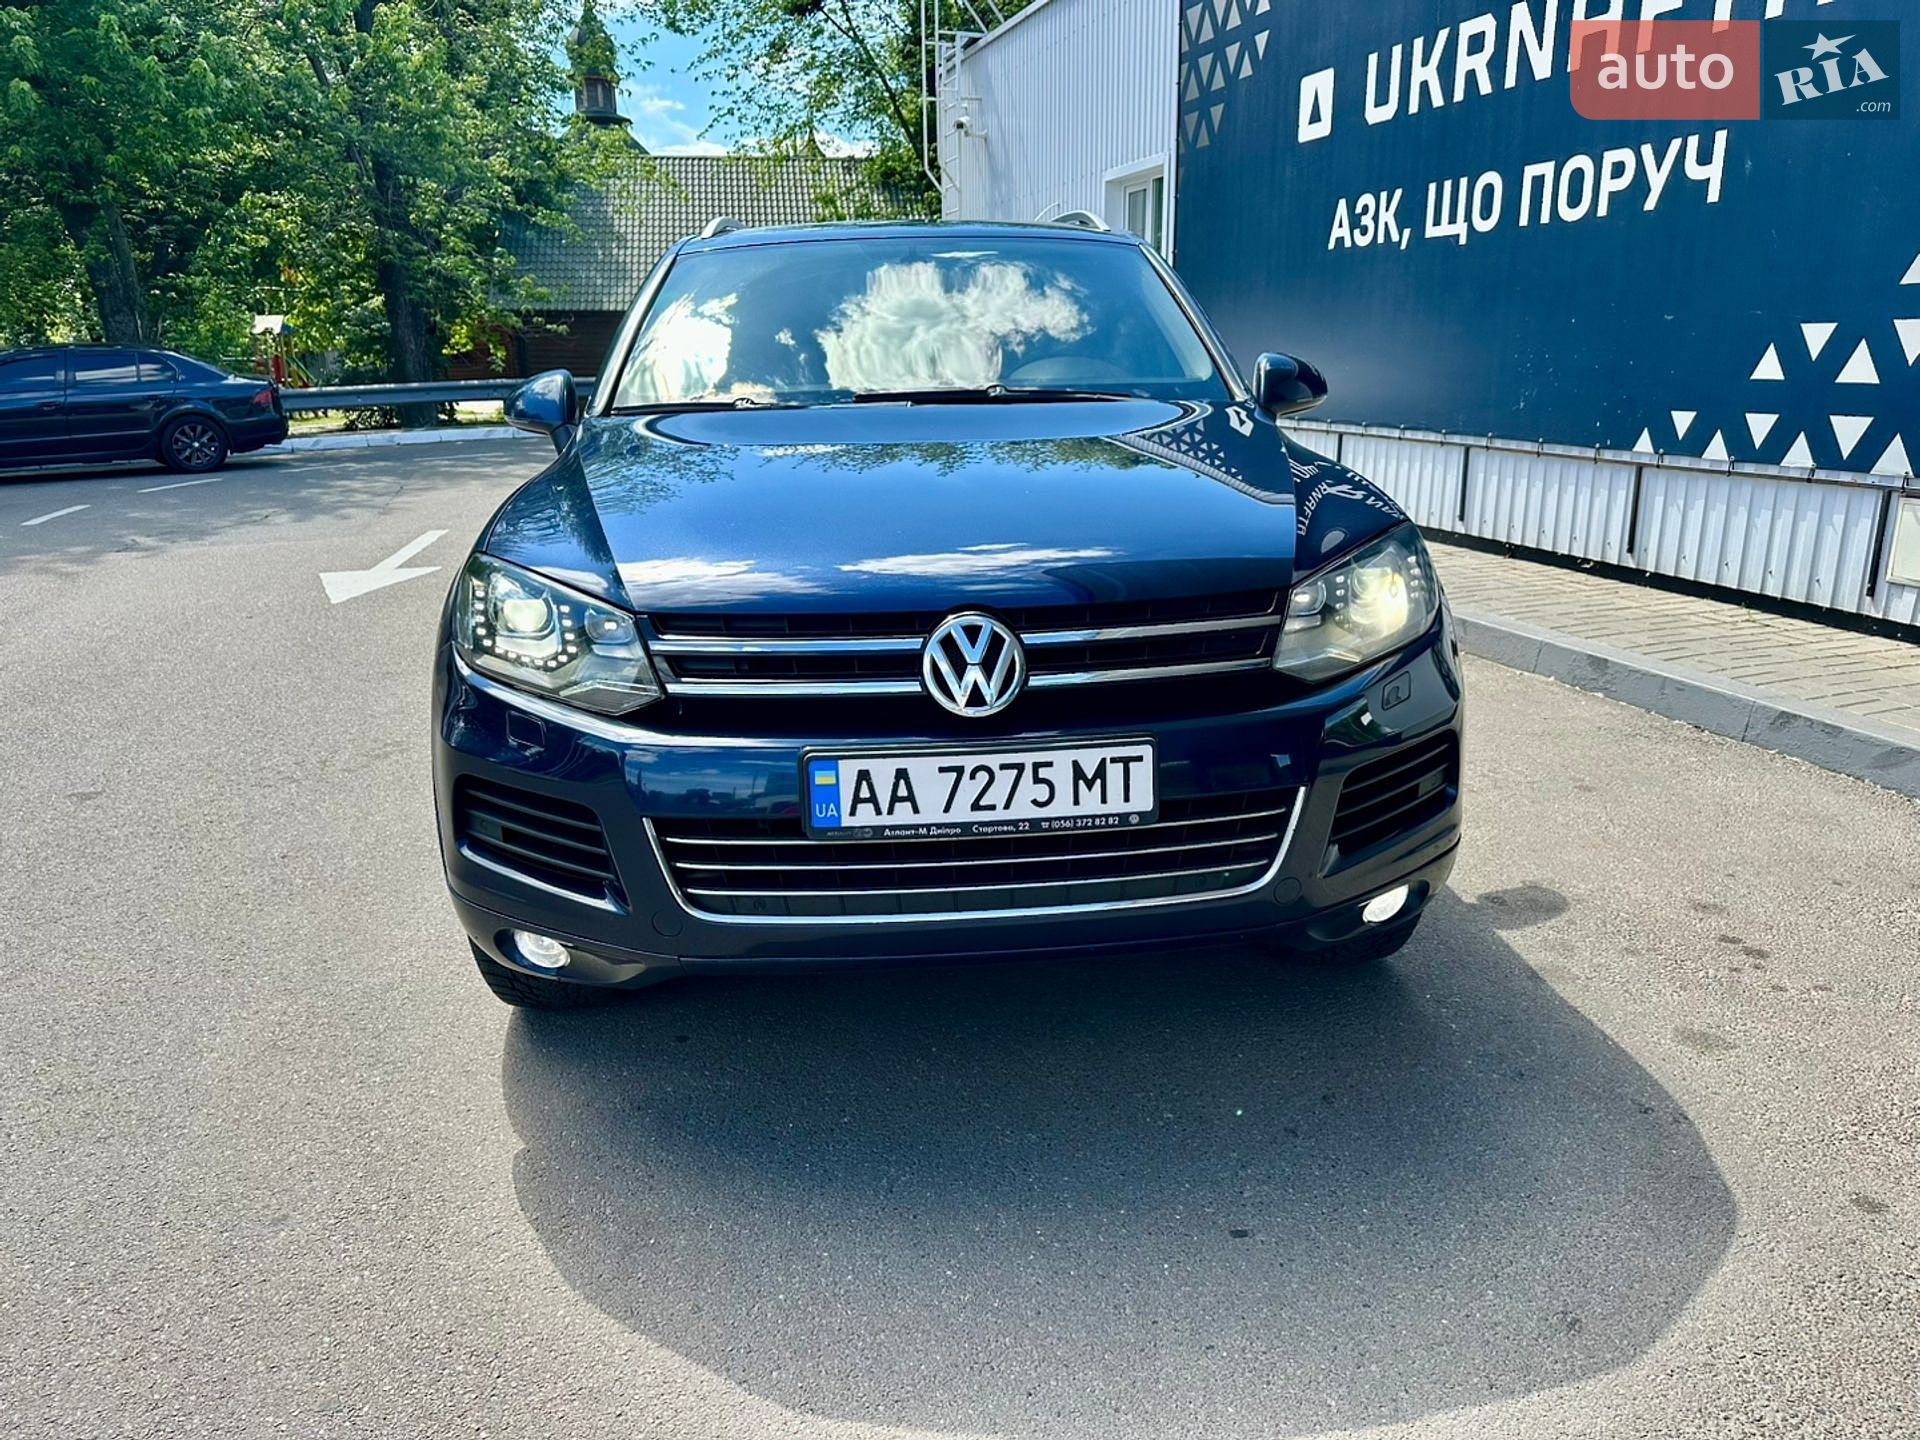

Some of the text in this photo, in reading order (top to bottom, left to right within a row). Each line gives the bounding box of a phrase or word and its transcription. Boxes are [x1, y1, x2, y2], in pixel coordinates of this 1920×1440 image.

[1328, 129, 1728, 250] АЗК, ЩО ПОРУЧ
[925, 615, 1022, 714] VW
[848, 755, 1144, 817] AA 7275 MT
[815, 803, 839, 818] UA
[1018, 822, 1030, 831] 22
[1051, 816, 1119, 830] (056) 372 82 82
